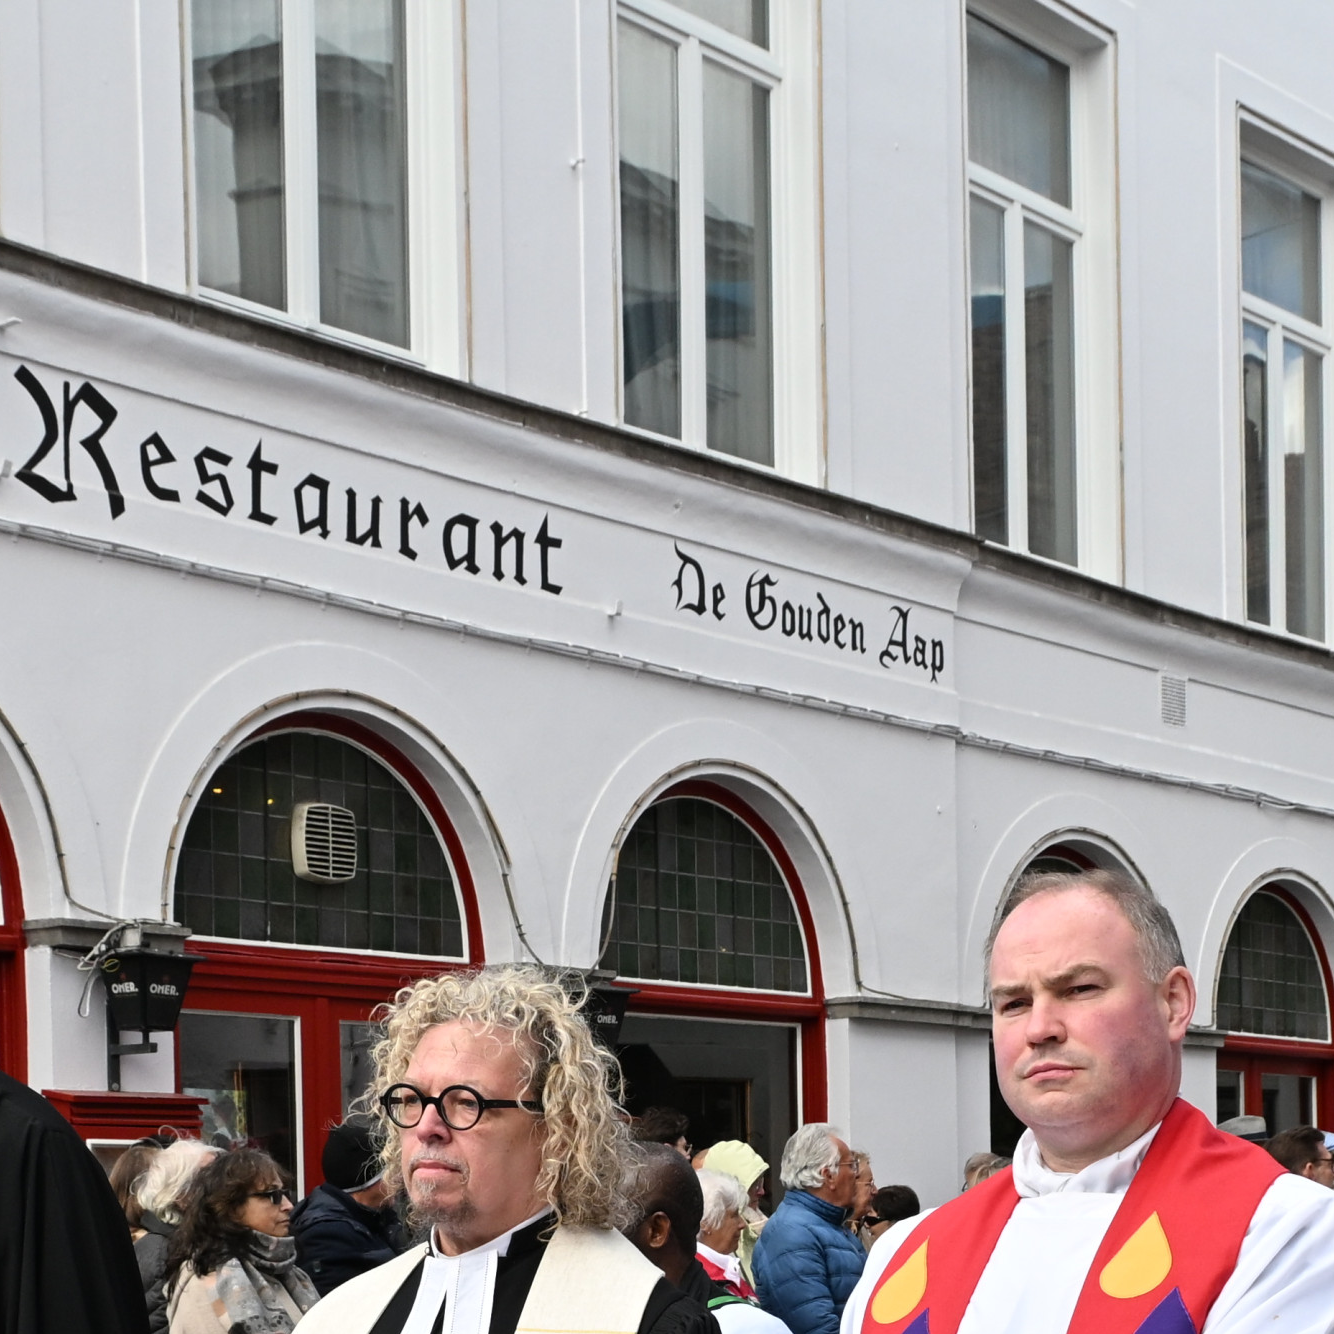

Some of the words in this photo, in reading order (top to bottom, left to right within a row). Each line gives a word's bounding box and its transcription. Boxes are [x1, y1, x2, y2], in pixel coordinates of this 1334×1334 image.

[13, 364, 563, 595] Restaurant
[671, 539, 726, 621] De
[745, 569, 867, 654] Gouden
[879, 605, 944, 684] Aap
